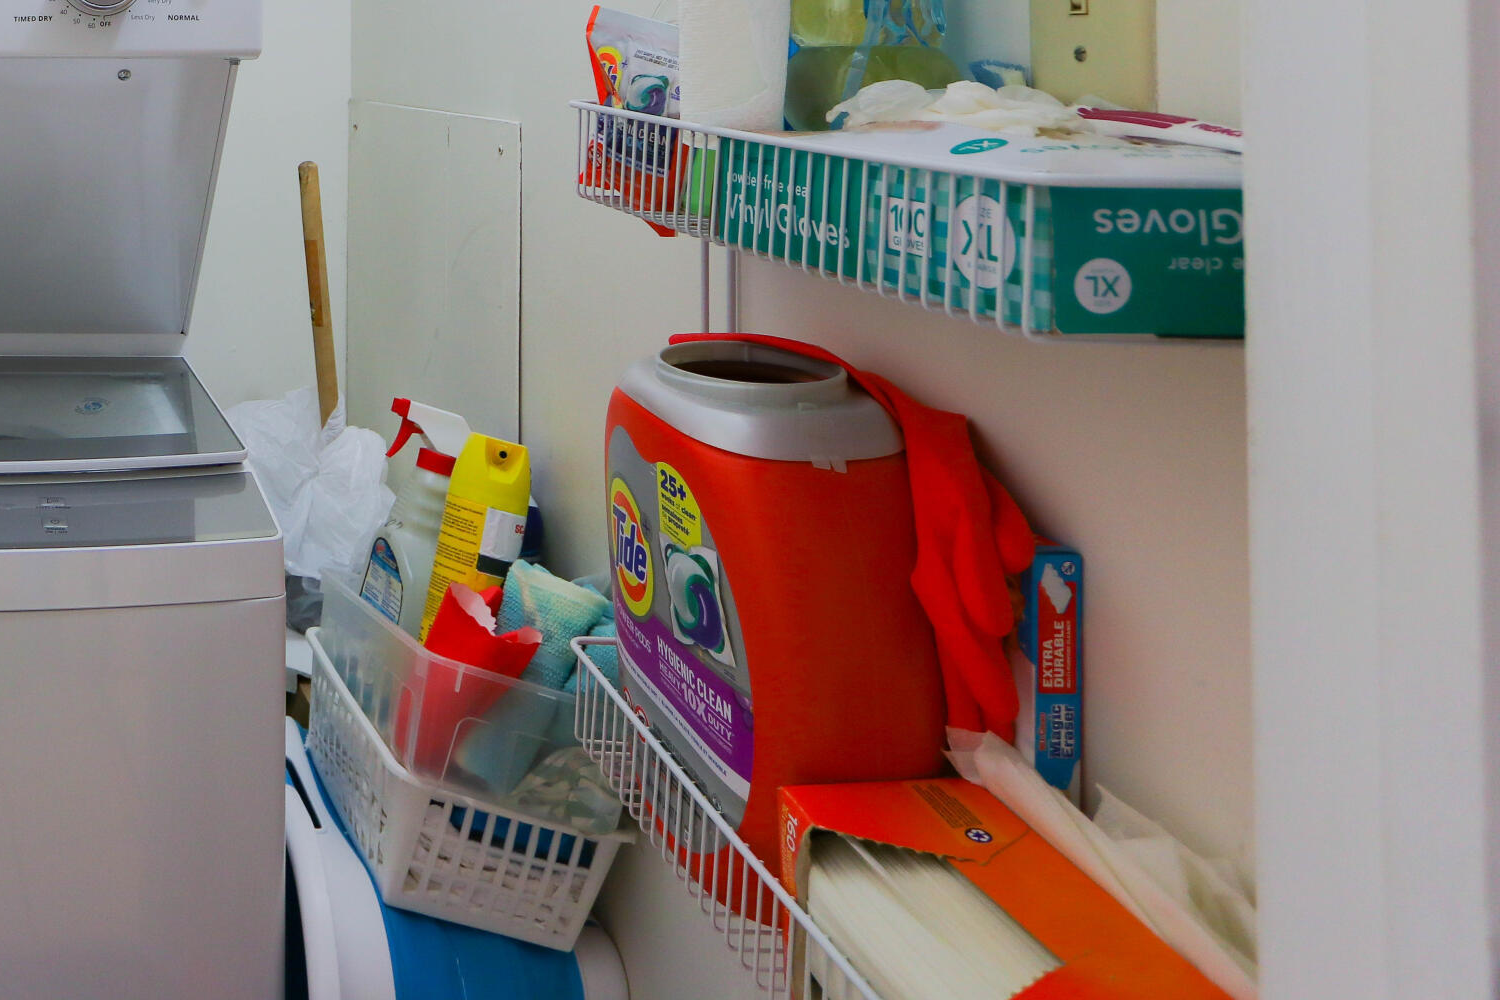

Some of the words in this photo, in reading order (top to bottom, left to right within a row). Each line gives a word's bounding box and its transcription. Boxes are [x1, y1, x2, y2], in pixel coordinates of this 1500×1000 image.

[1092, 208, 1243, 246] Gloves
[1084, 275, 1120, 298] XL
[1168, 256, 1223, 276] clear
[612, 503, 648, 584] Tide
[657, 635, 696, 688] HYGIENIC
[697, 677, 732, 724] CLEAN
[1042, 639, 1053, 689] EXTRA
[1053, 620, 1065, 689] DURABLE
[659, 661, 682, 692] HEAVY
[681, 682, 708, 724] 10X
[707, 715, 733, 741] DUTY
[786, 813, 798, 853] 160
